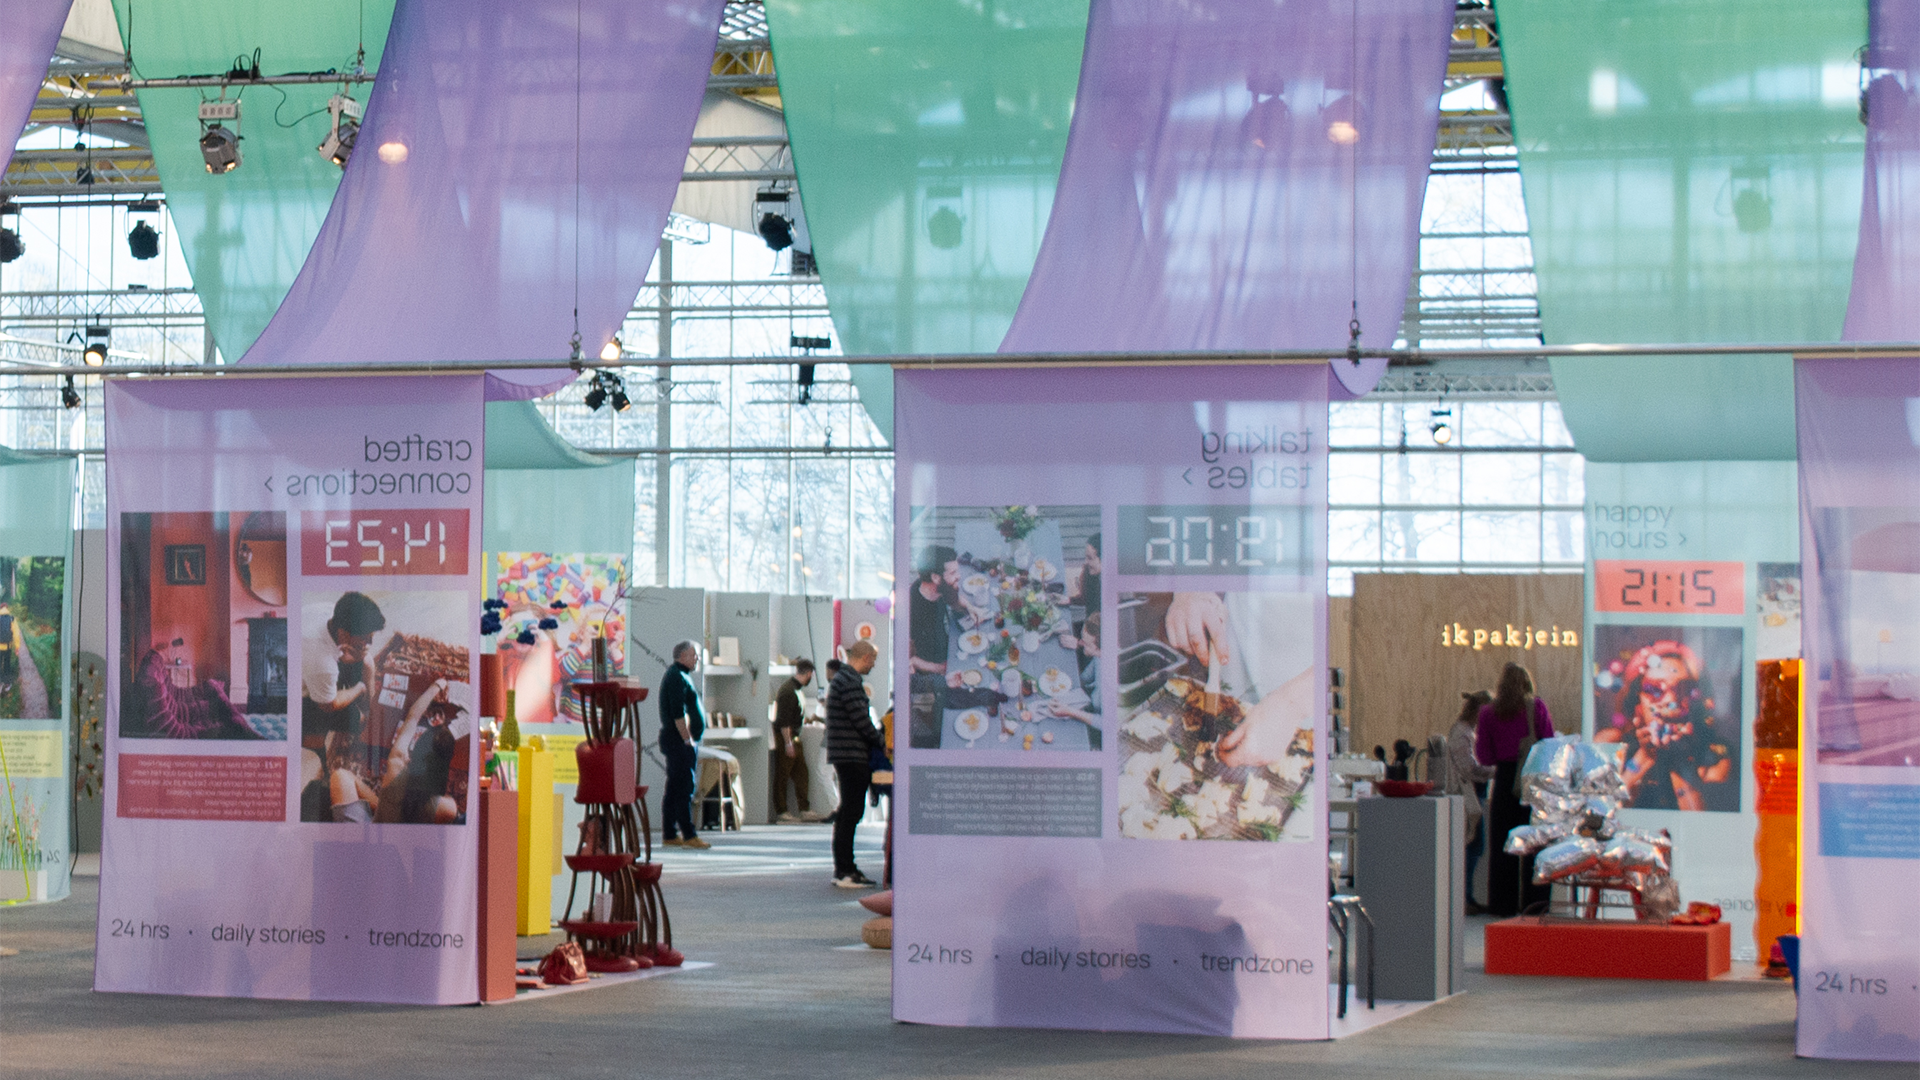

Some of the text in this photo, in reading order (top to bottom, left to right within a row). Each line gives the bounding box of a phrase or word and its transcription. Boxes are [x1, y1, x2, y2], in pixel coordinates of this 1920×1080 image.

[1594, 502, 1673, 528] happy
[1594, 527, 1667, 548] hours
[1622, 568, 1716, 606] 21:15
[112, 918, 463, 948] 24 hrs daily stories trendzone
[907, 943, 1314, 974] 24 hrs daily stories trendzone
[1815, 971, 1888, 995] 24 hrs
